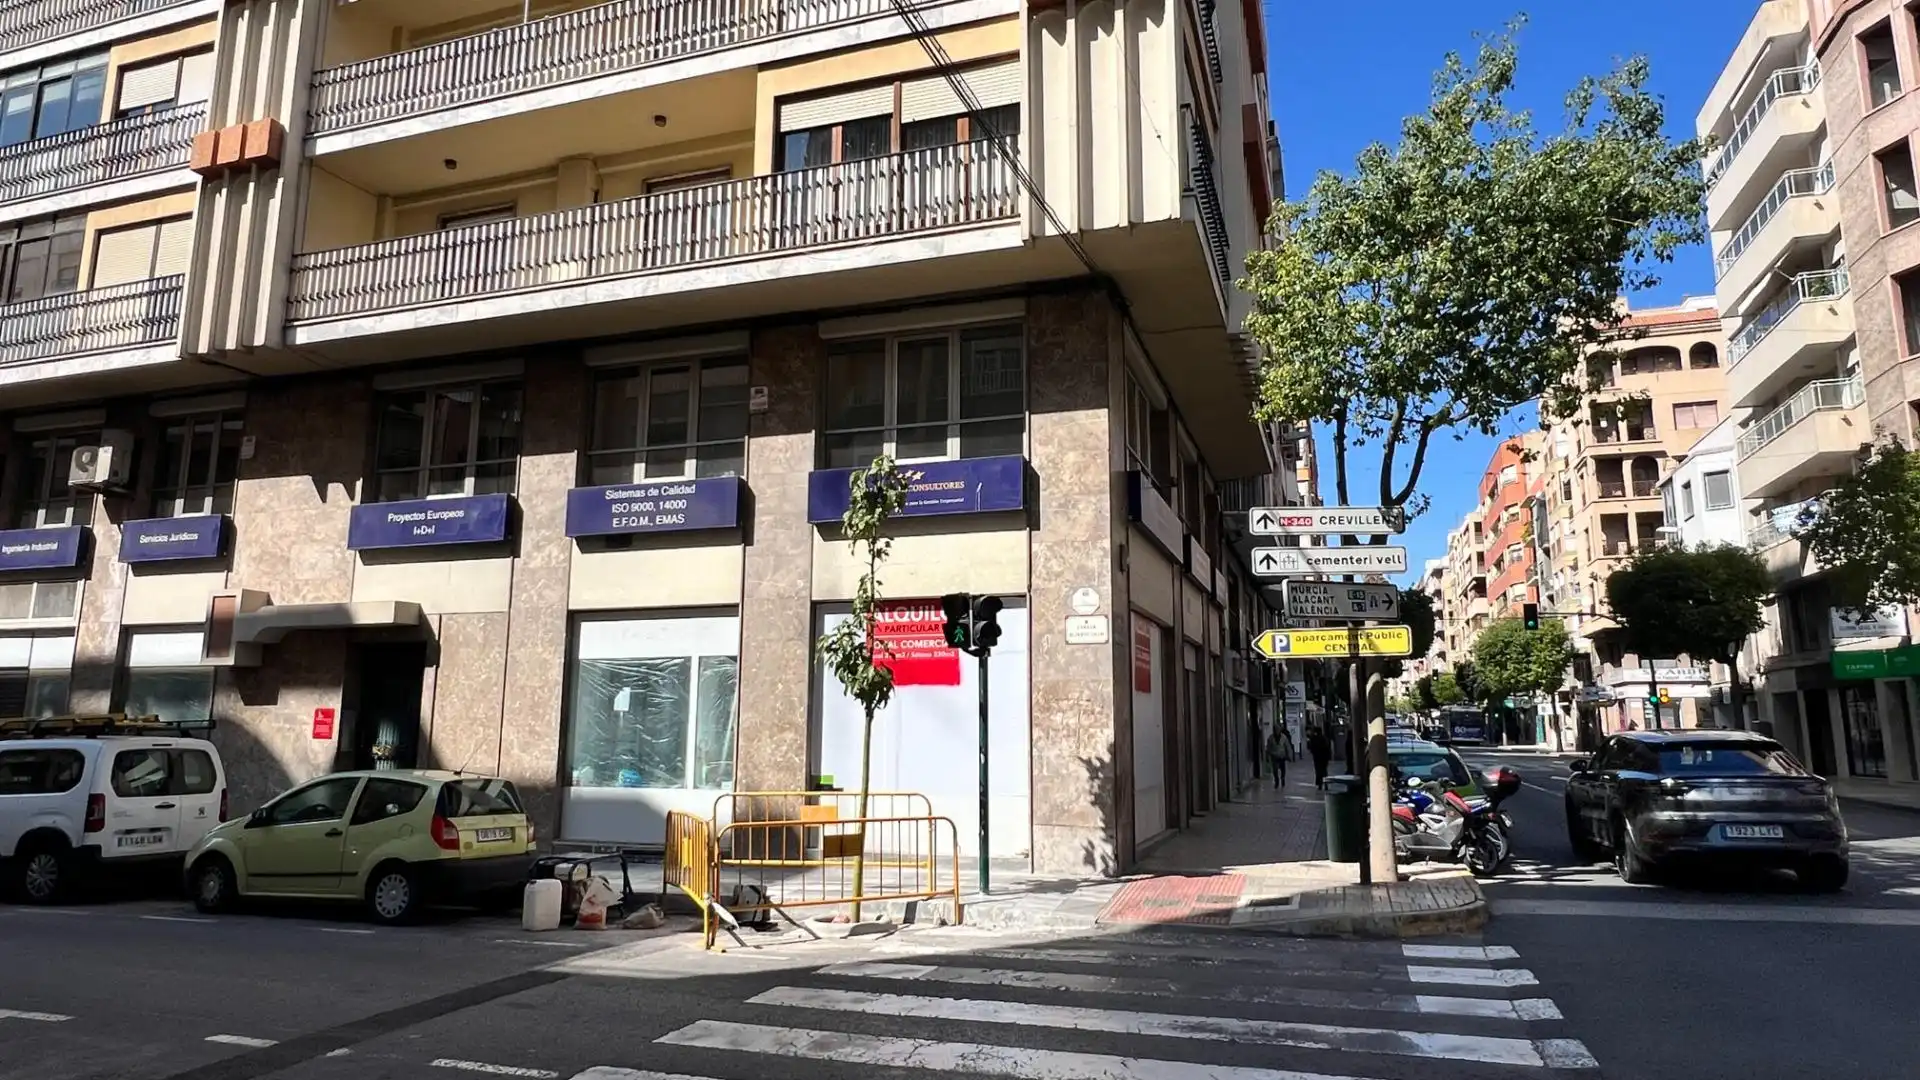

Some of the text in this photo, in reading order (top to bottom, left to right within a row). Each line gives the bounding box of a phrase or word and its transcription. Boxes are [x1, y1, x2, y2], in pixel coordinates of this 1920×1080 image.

[605, 484, 696, 500] Sistemas de Calidad
[908, 481, 965, 492] CONSULTORES
[612, 499, 687, 514] ISO 9000, 14000
[387, 509, 465, 523] Proyectos Europeos
[656, 514, 685, 525] EMAS
[1280, 515, 1393, 526] N-340 CREVILLEN
[139, 534, 168, 544] Servicios
[31, 541, 58, 551] Industrial
[1306, 553, 1402, 565] cementeri vell
[1291, 585, 1328, 594] MURCIA
[1292, 595, 1335, 604] ALACANT
[884, 623, 940, 633] PARTICULAR
[1296, 632, 1363, 643] aparcament
[901, 639, 949, 649] COMERCIA
[1324, 643, 1375, 652] CENTRAL
